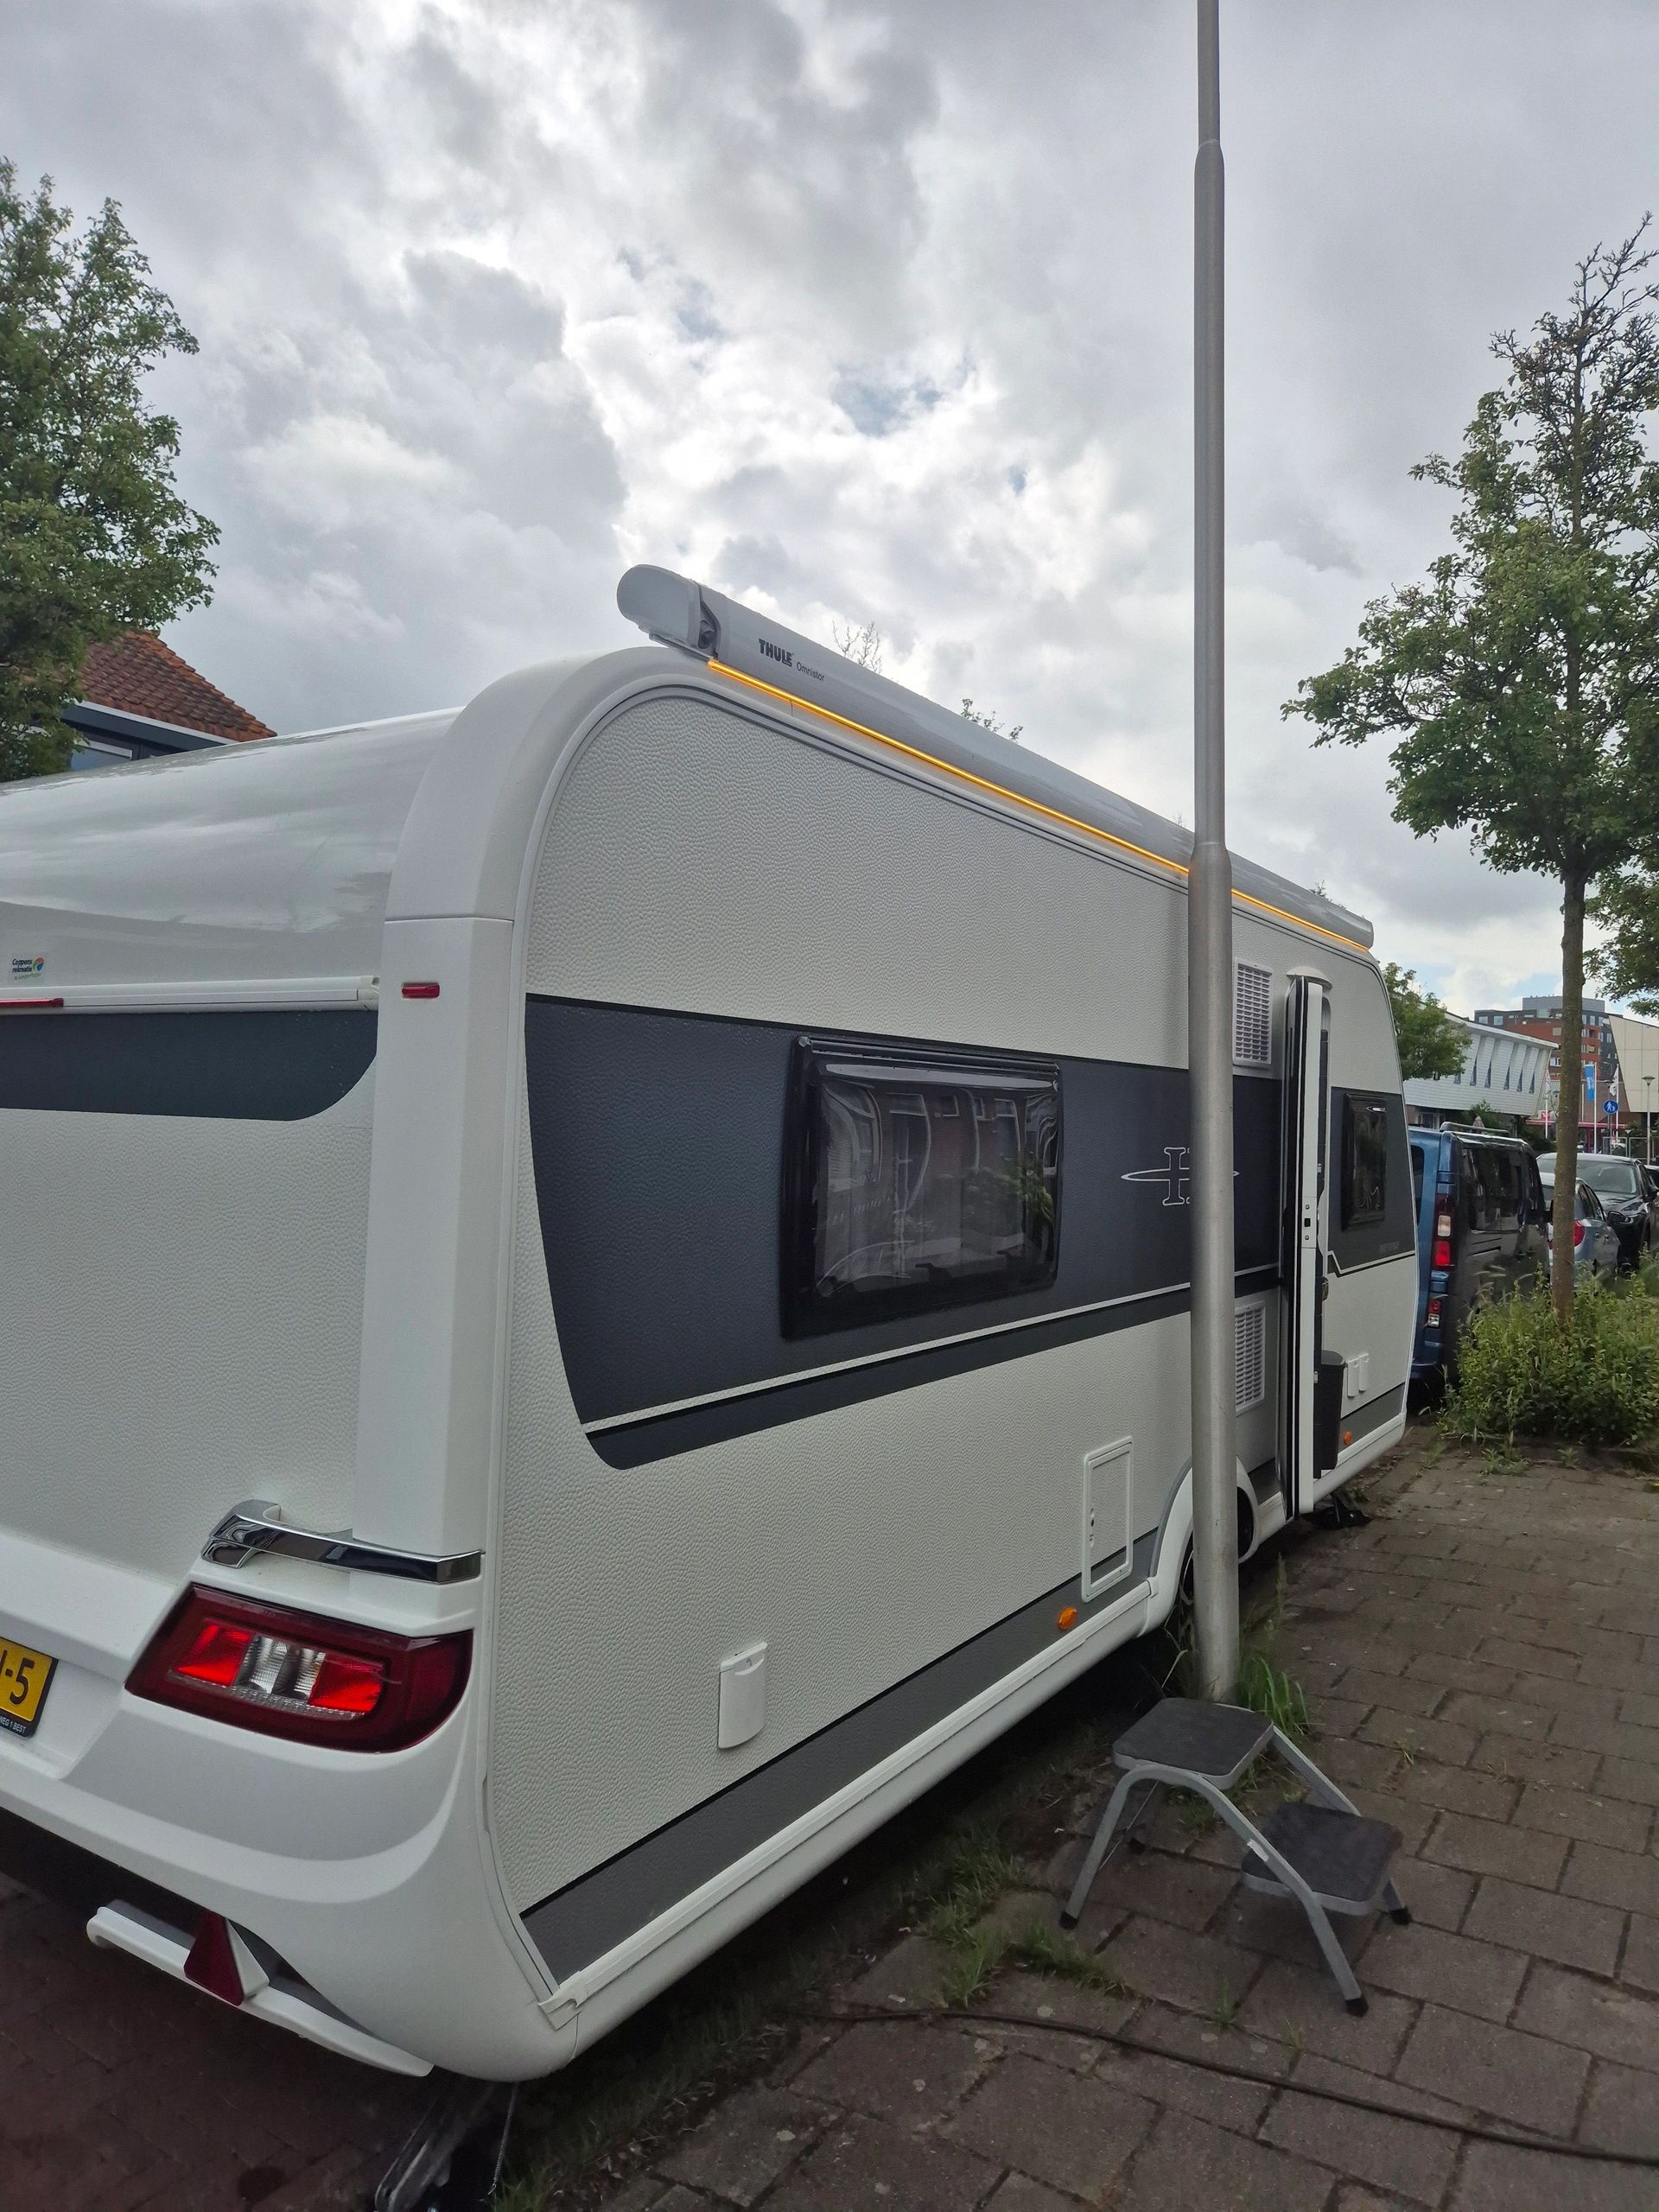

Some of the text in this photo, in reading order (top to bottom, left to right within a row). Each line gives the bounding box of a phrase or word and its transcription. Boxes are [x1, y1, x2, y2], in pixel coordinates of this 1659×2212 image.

[759, 638, 824, 682] THULE Omnistor
[12, 958, 33, 968] Coppens
[13, 1722, 27, 1734] BEST
